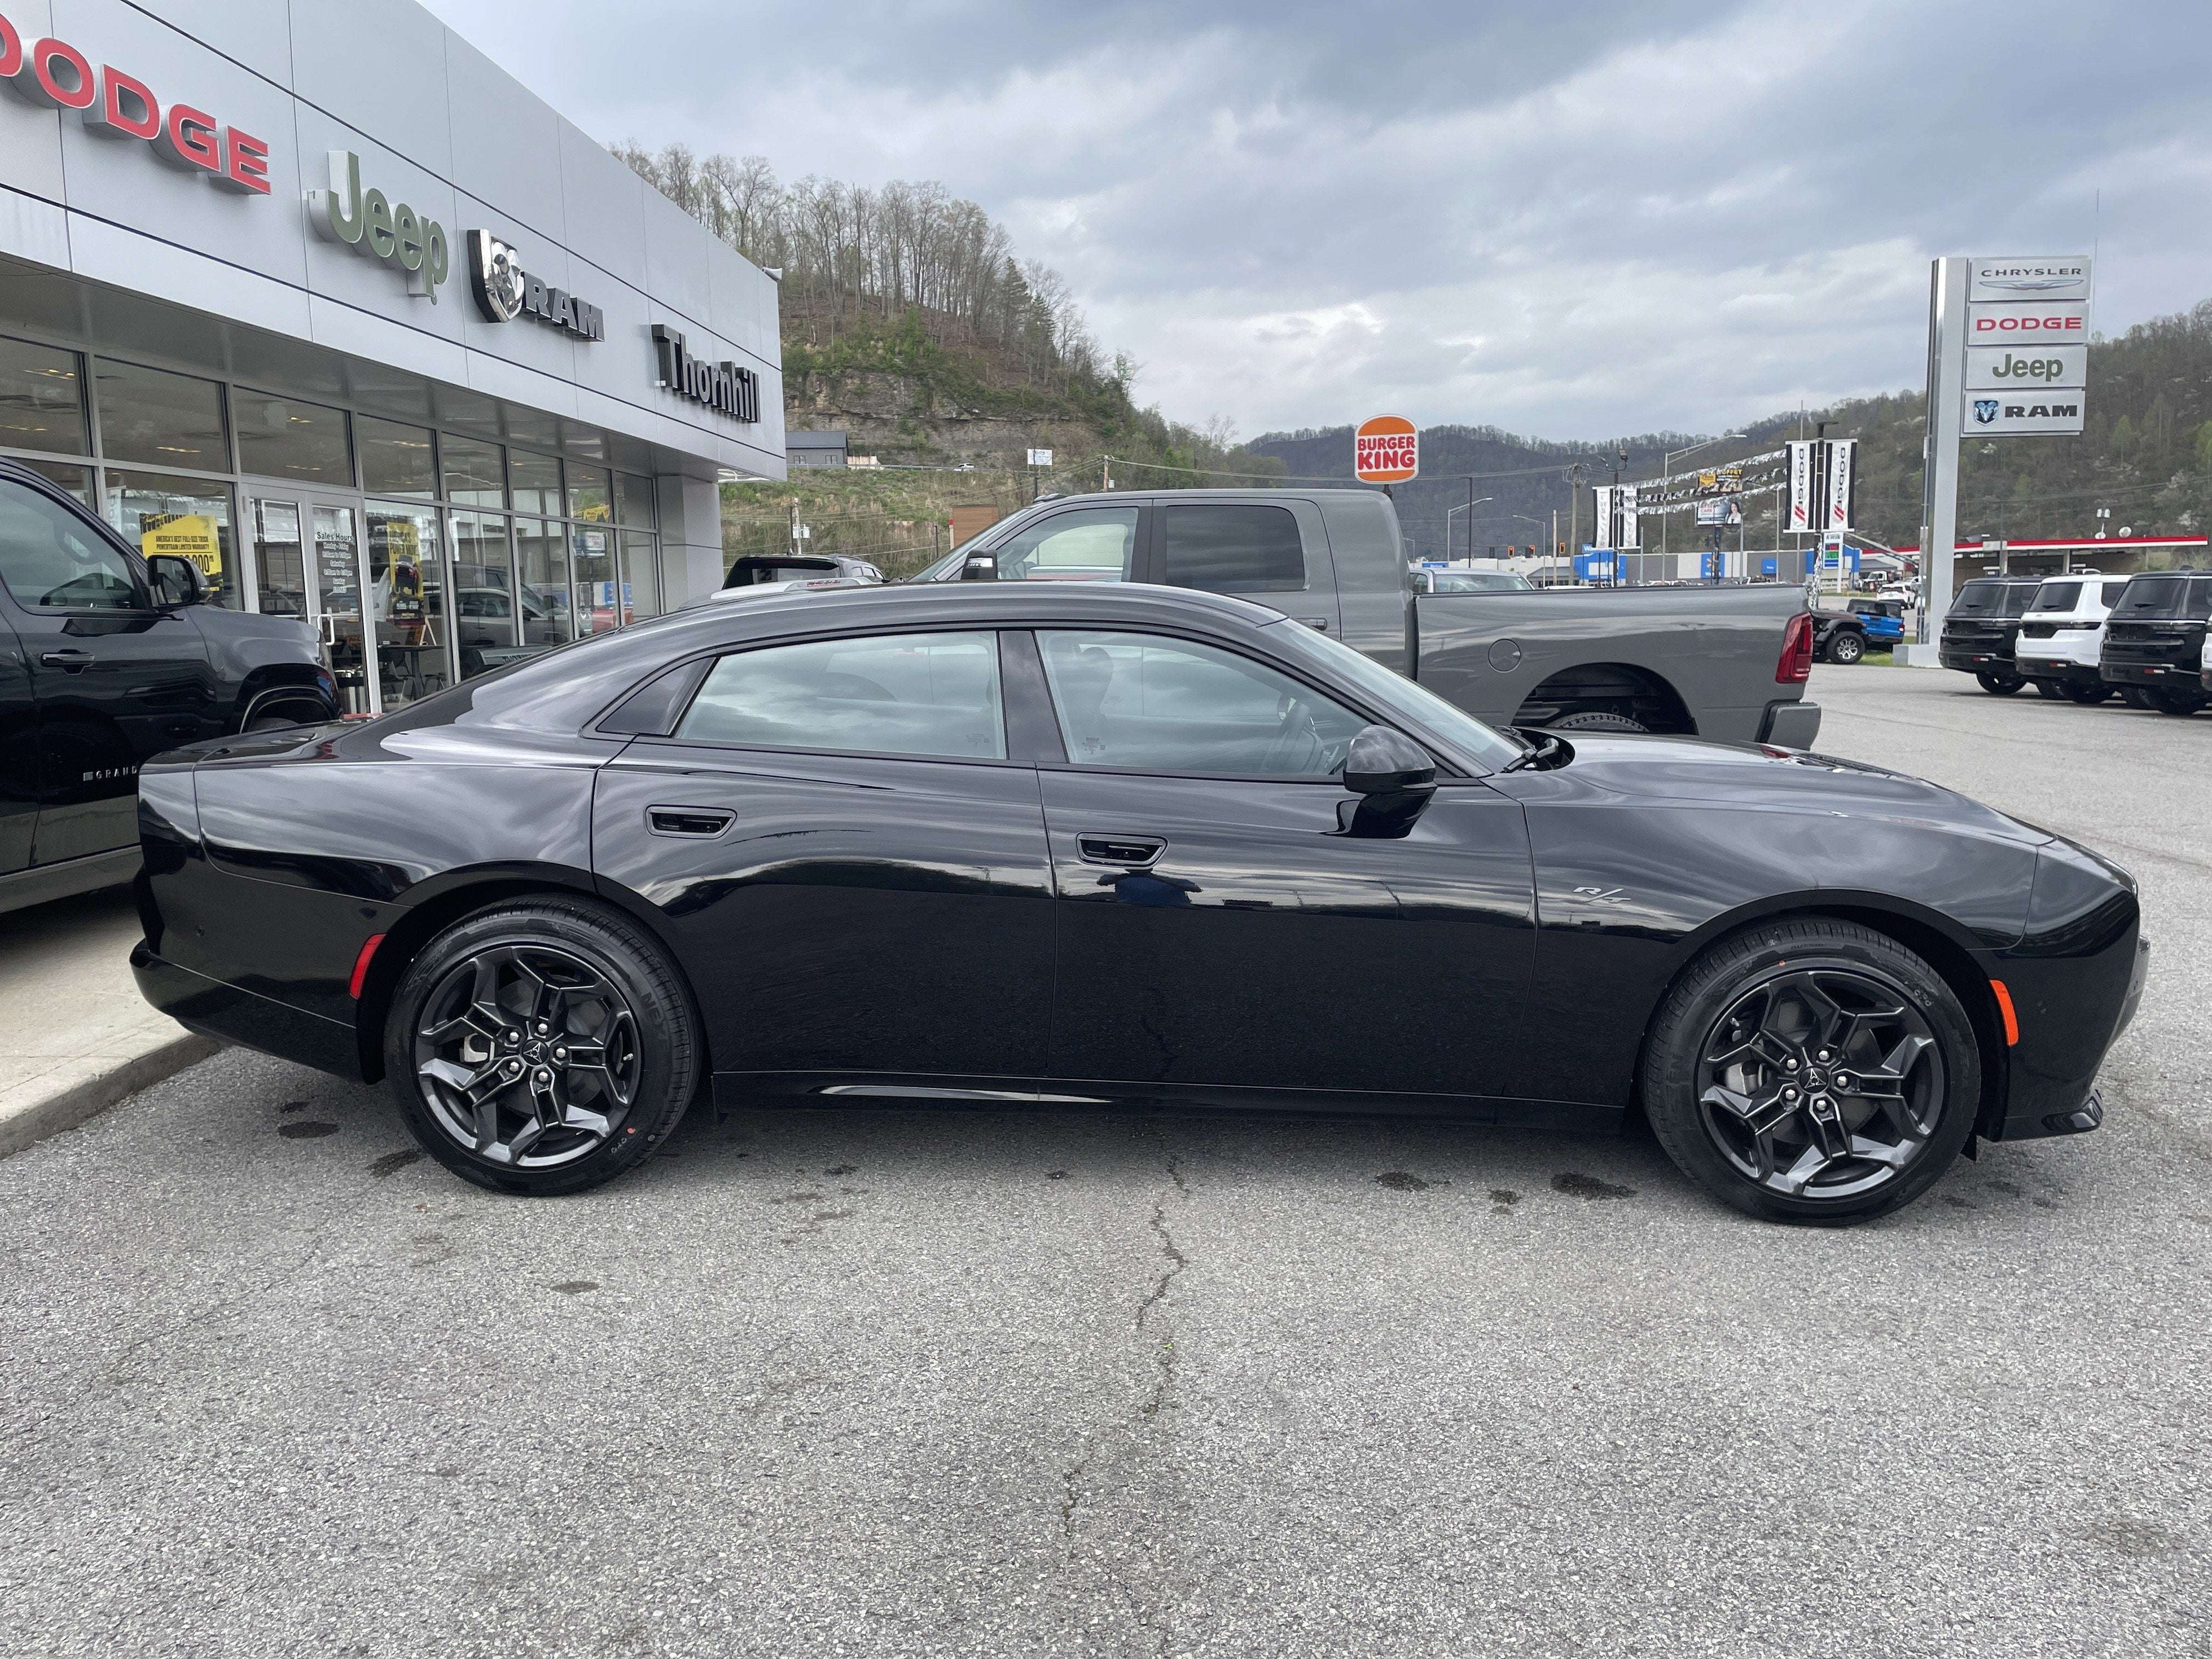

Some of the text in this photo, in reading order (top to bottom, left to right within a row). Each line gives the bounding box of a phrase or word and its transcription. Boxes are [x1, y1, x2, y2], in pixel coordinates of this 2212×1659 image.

[324, 150, 449, 297] Jeep
[1980, 268, 2082, 277] CHRYSLER
[523, 272, 605, 342] RAM
[1976, 317, 2082, 332] DODGE
[653, 324, 761, 424] Thornhill
[1992, 353, 2064, 382] Jeep
[2005, 405, 2078, 419] RAM
[1358, 436, 1416, 452] BURGER
[1358, 449, 1416, 471] KING
[317, 531, 353, 541] Sales Hours
[96, 766, 138, 780] GRAND
[1572, 887, 1632, 904] R/T
